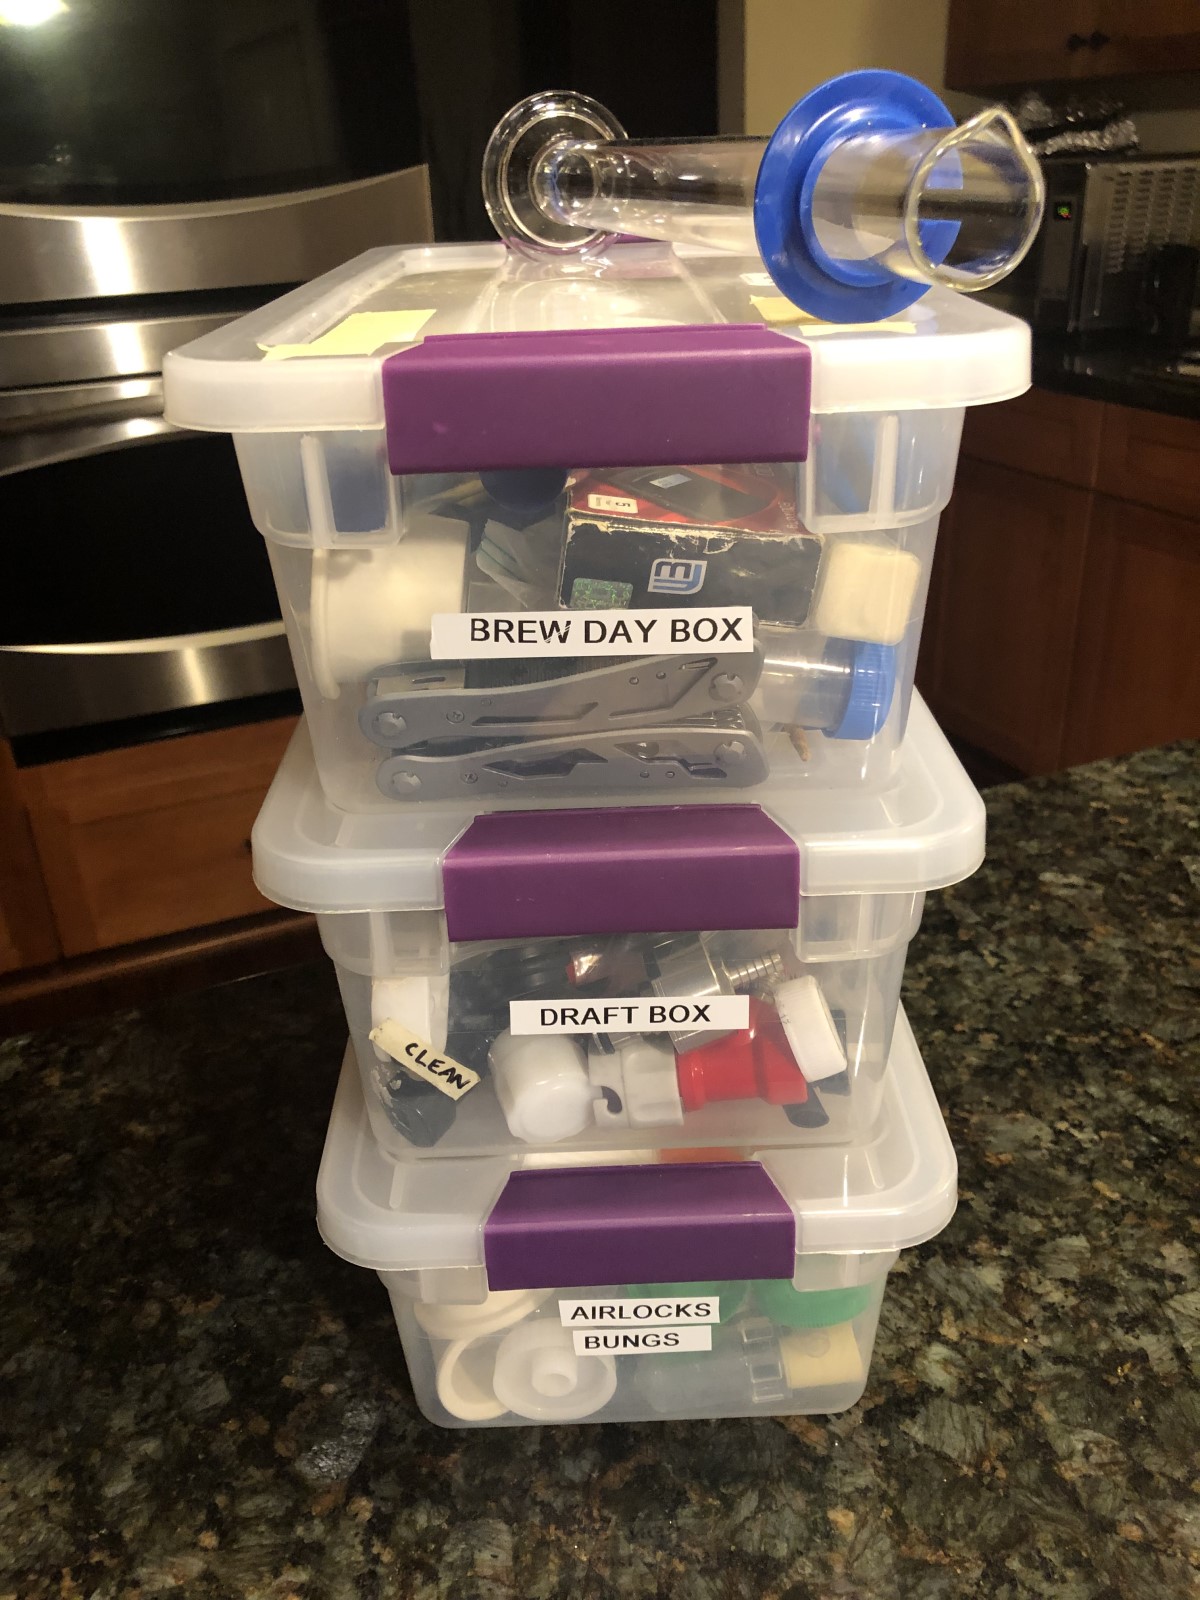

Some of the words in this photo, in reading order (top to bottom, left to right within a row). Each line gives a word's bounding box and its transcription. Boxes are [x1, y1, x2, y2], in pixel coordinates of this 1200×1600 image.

[471, 618, 571, 643] BREW
[585, 619, 657, 644] DAY
[671, 617, 742, 642] BOX
[541, 1006, 638, 1026] DRAFT
[649, 1004, 711, 1024] BOX
[405, 1042, 471, 1089] CLEAN
[571, 1302, 711, 1320] AIRLOCKS
[584, 1332, 680, 1349] BUNGS
